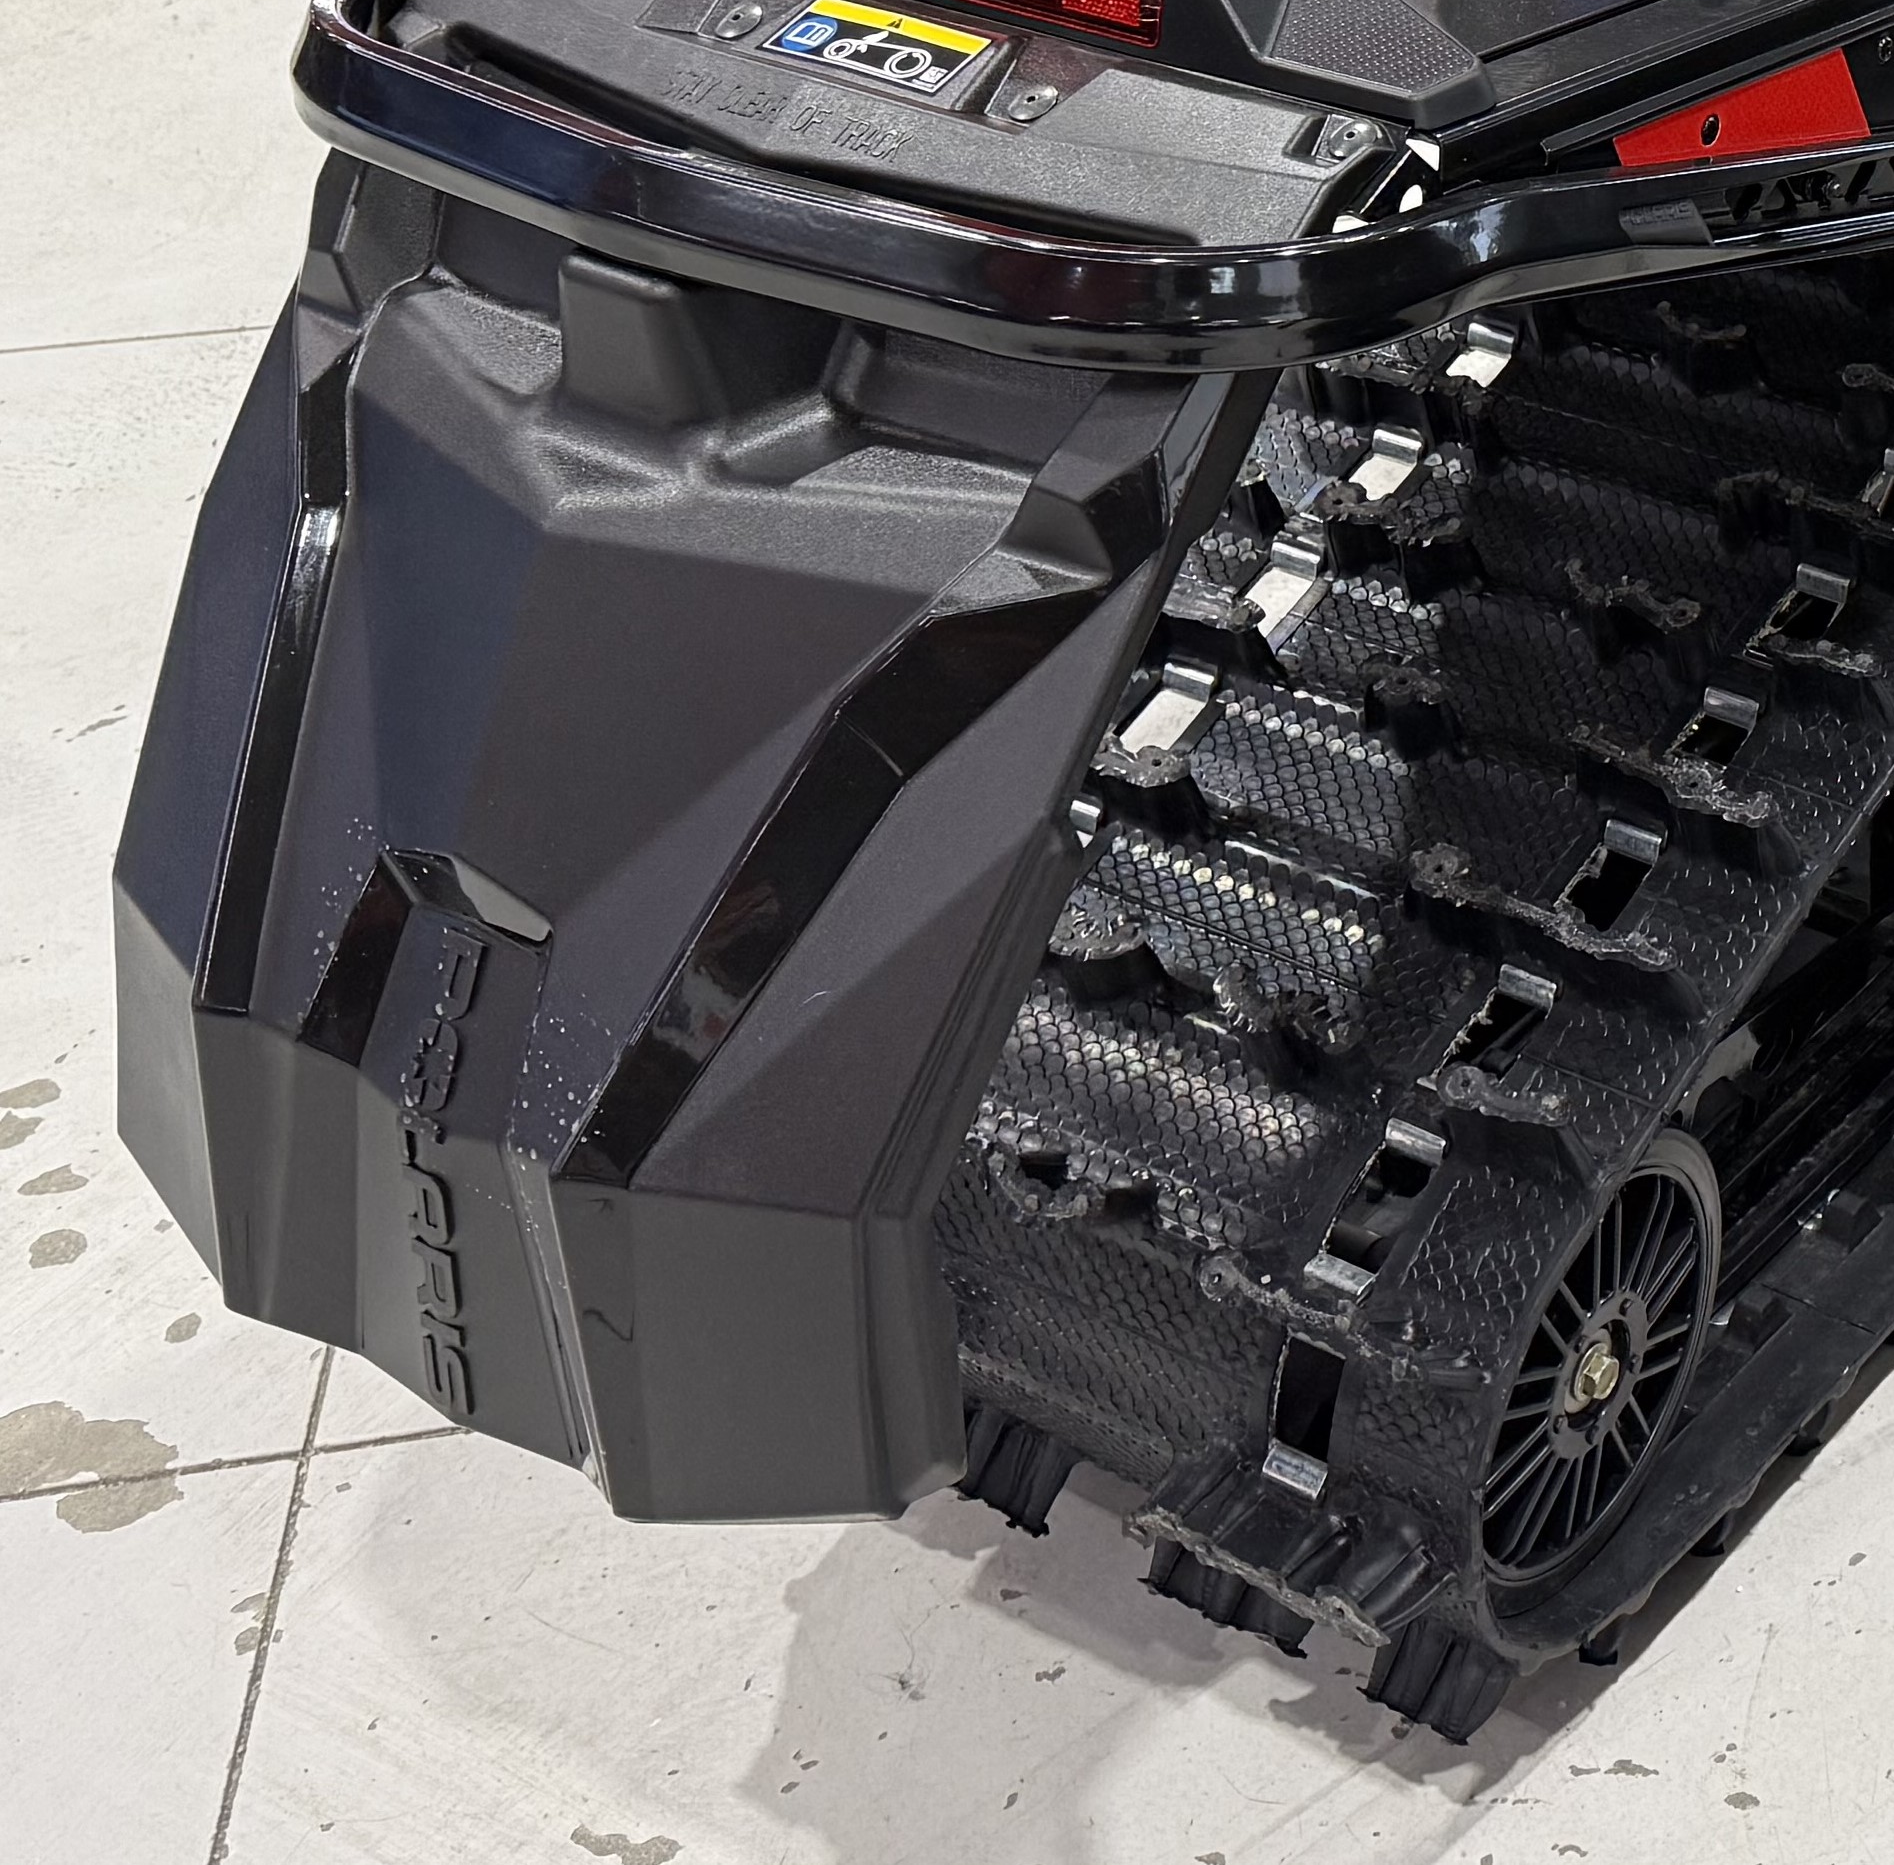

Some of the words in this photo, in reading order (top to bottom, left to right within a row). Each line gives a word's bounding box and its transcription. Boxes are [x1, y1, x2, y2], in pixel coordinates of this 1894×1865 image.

[716, 84, 788, 125] CLEAR
[789, 104, 833, 134] OF
[831, 115, 917, 163] TRACK
[401, 927, 489, 1416] POLARIS
